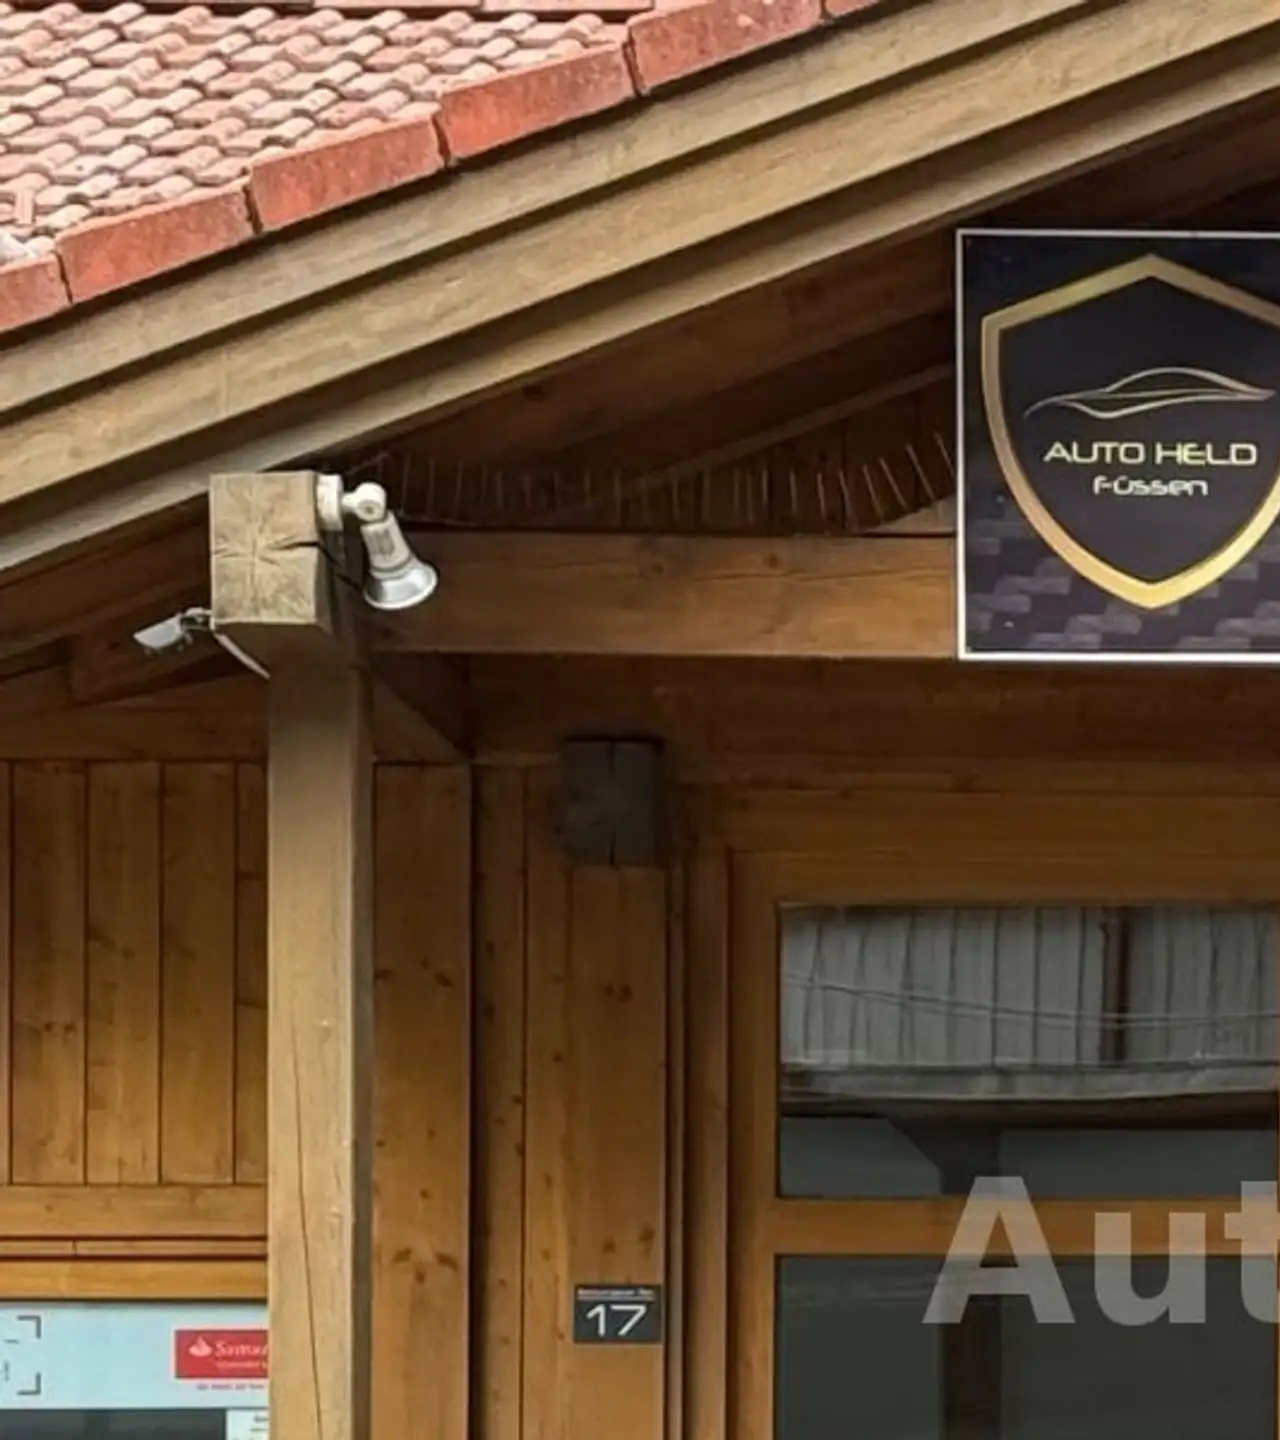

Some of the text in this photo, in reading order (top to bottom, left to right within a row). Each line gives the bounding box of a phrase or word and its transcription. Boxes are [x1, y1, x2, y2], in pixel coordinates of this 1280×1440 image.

[1044, 440, 1258, 466] AUTO HELD
[585, 1303, 648, 1338] 17
